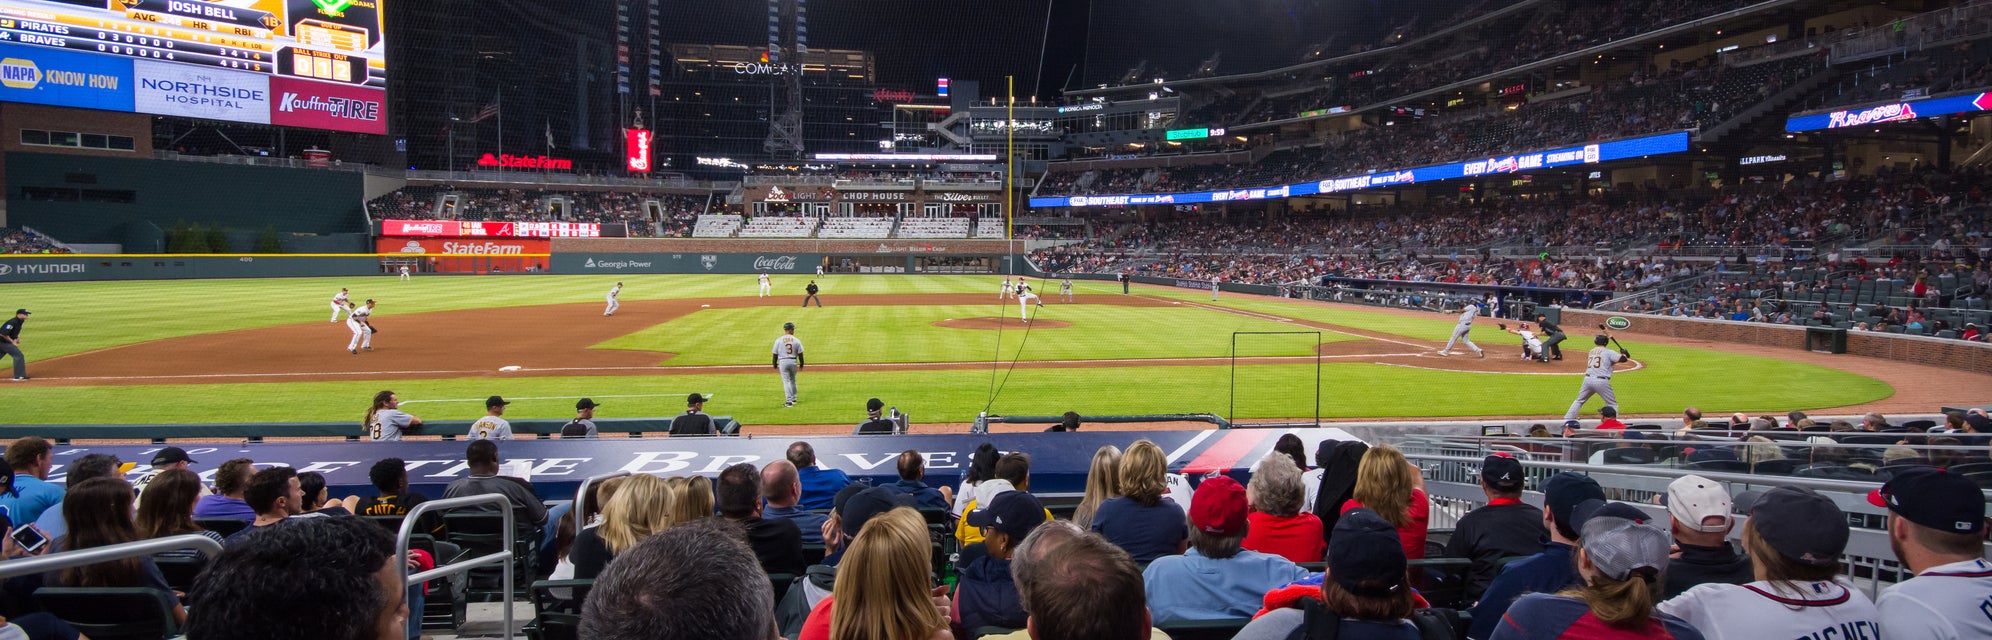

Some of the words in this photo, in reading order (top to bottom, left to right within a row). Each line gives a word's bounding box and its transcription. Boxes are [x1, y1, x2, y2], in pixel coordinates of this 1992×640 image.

[168, 0, 201, 14] JOSH
[205, 6, 237, 20] BELL
[317, 8, 345, 18] FLERS
[133, 12, 156, 22] AVG
[263, 16, 279, 27] 1B
[193, 21, 208, 30] HR
[234, 27, 251, 36] RBI
[21, 21, 69, 35] PIRATES
[98, 32, 105, 40] 0
[140, 37, 147, 45] 0
[153, 39, 160, 47] 0
[220, 48, 226, 56] 3
[243, 51, 248, 59] 1
[20, 34, 65, 47] BRAVES
[112, 45, 119, 53] 0
[126, 47, 133, 55] 0
[140, 49, 147, 57] 0
[154, 51, 160, 59] 0
[166, 52, 174, 60] 4
[220, 59, 227, 67] 4
[231, 60, 238, 68] 8
[294, 48, 311, 56] BALL
[334, 53, 348, 61] OUT
[3, 65, 36, 81] NAPA
[319, 60, 327, 75] 1
[336, 63, 347, 77] 2
[46, 69, 85, 86] KNOW
[89, 73, 118, 90] HOW
[142, 78, 264, 101] NORTHSIDE
[873, 88, 916, 103] xfinity
[166, 94, 243, 109] HOSPITAL
[279, 91, 345, 114] Kauffman
[329, 97, 379, 120] TIRE
[1828, 103, 1901, 128] Braves
[1173, 131, 1202, 139] StubHub
[1210, 128, 1225, 137] 9:59
[1464, 162, 1486, 175] EVERY
[1518, 154, 1543, 169] GAME
[1546, 152, 1575, 164] STREAMING
[1575, 151, 1584, 161] ON
[1334, 176, 1371, 190] SOUTHEAST
[793, 192, 816, 200] LIGHT
[843, 192, 869, 200] CHOP
[872, 192, 905, 200] HOUSE
[943, 192, 972, 201] Silver
[1088, 196, 1130, 205] SOUTHEAST
[1212, 192, 1229, 201] EVERY
[1249, 189, 1266, 199] GAME
[17, 263, 85, 274] HYUNDAI
[597, 260, 628, 269] Georgia
[628, 260, 652, 268] Power
[753, 255, 798, 270] Coca-Cola
[1609, 319, 1627, 327] Scotts
[785, 343, 793, 355] 3
